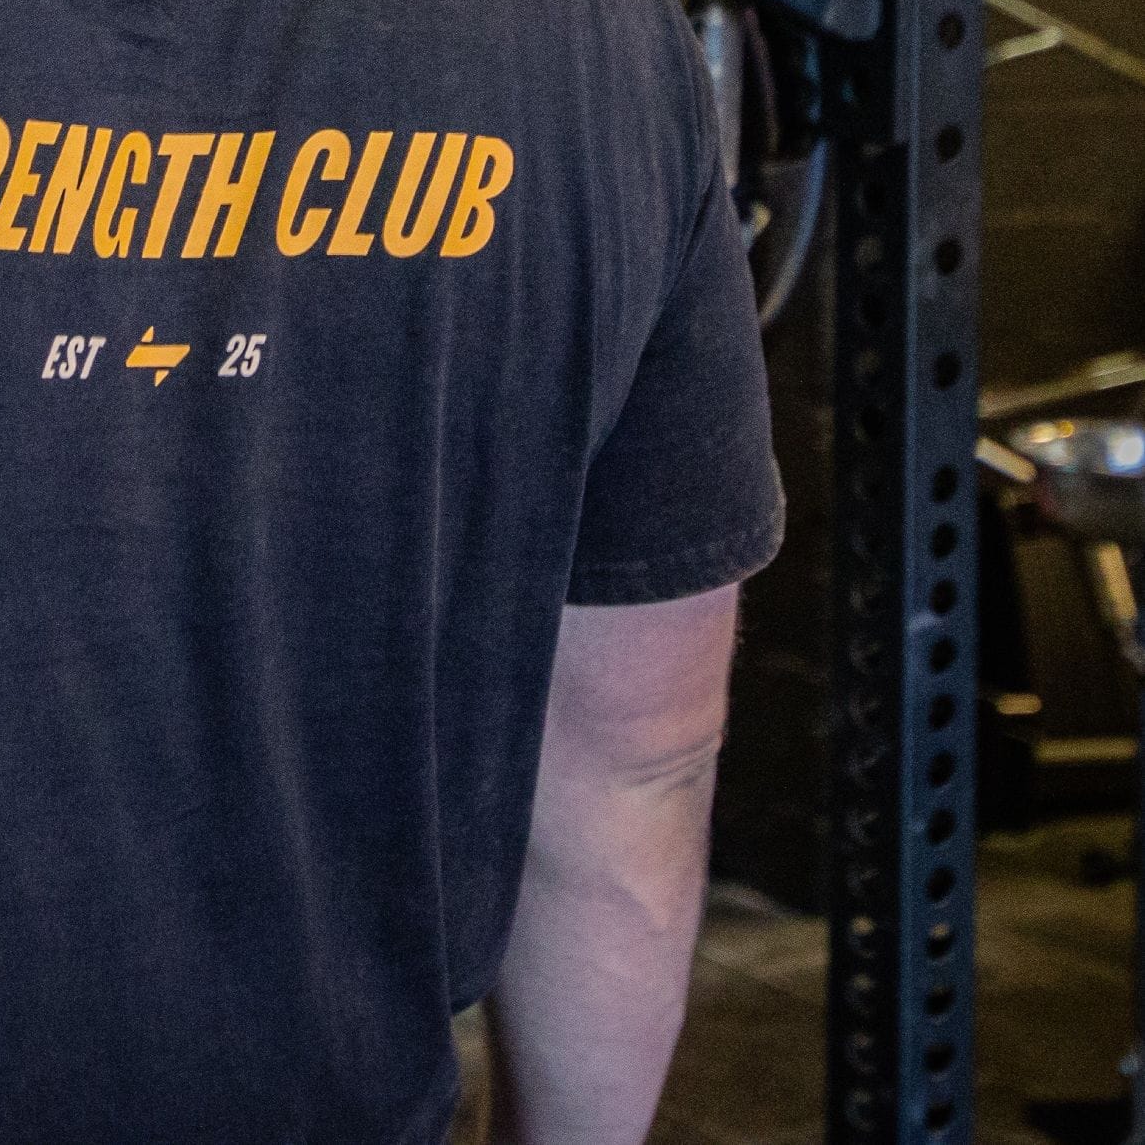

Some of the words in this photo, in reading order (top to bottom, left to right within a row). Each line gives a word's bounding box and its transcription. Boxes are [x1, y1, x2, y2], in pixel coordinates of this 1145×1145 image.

[275, 128, 515, 258] CLUB
[40, 334, 107, 380] EST
[217, 333, 268, 378] 25
